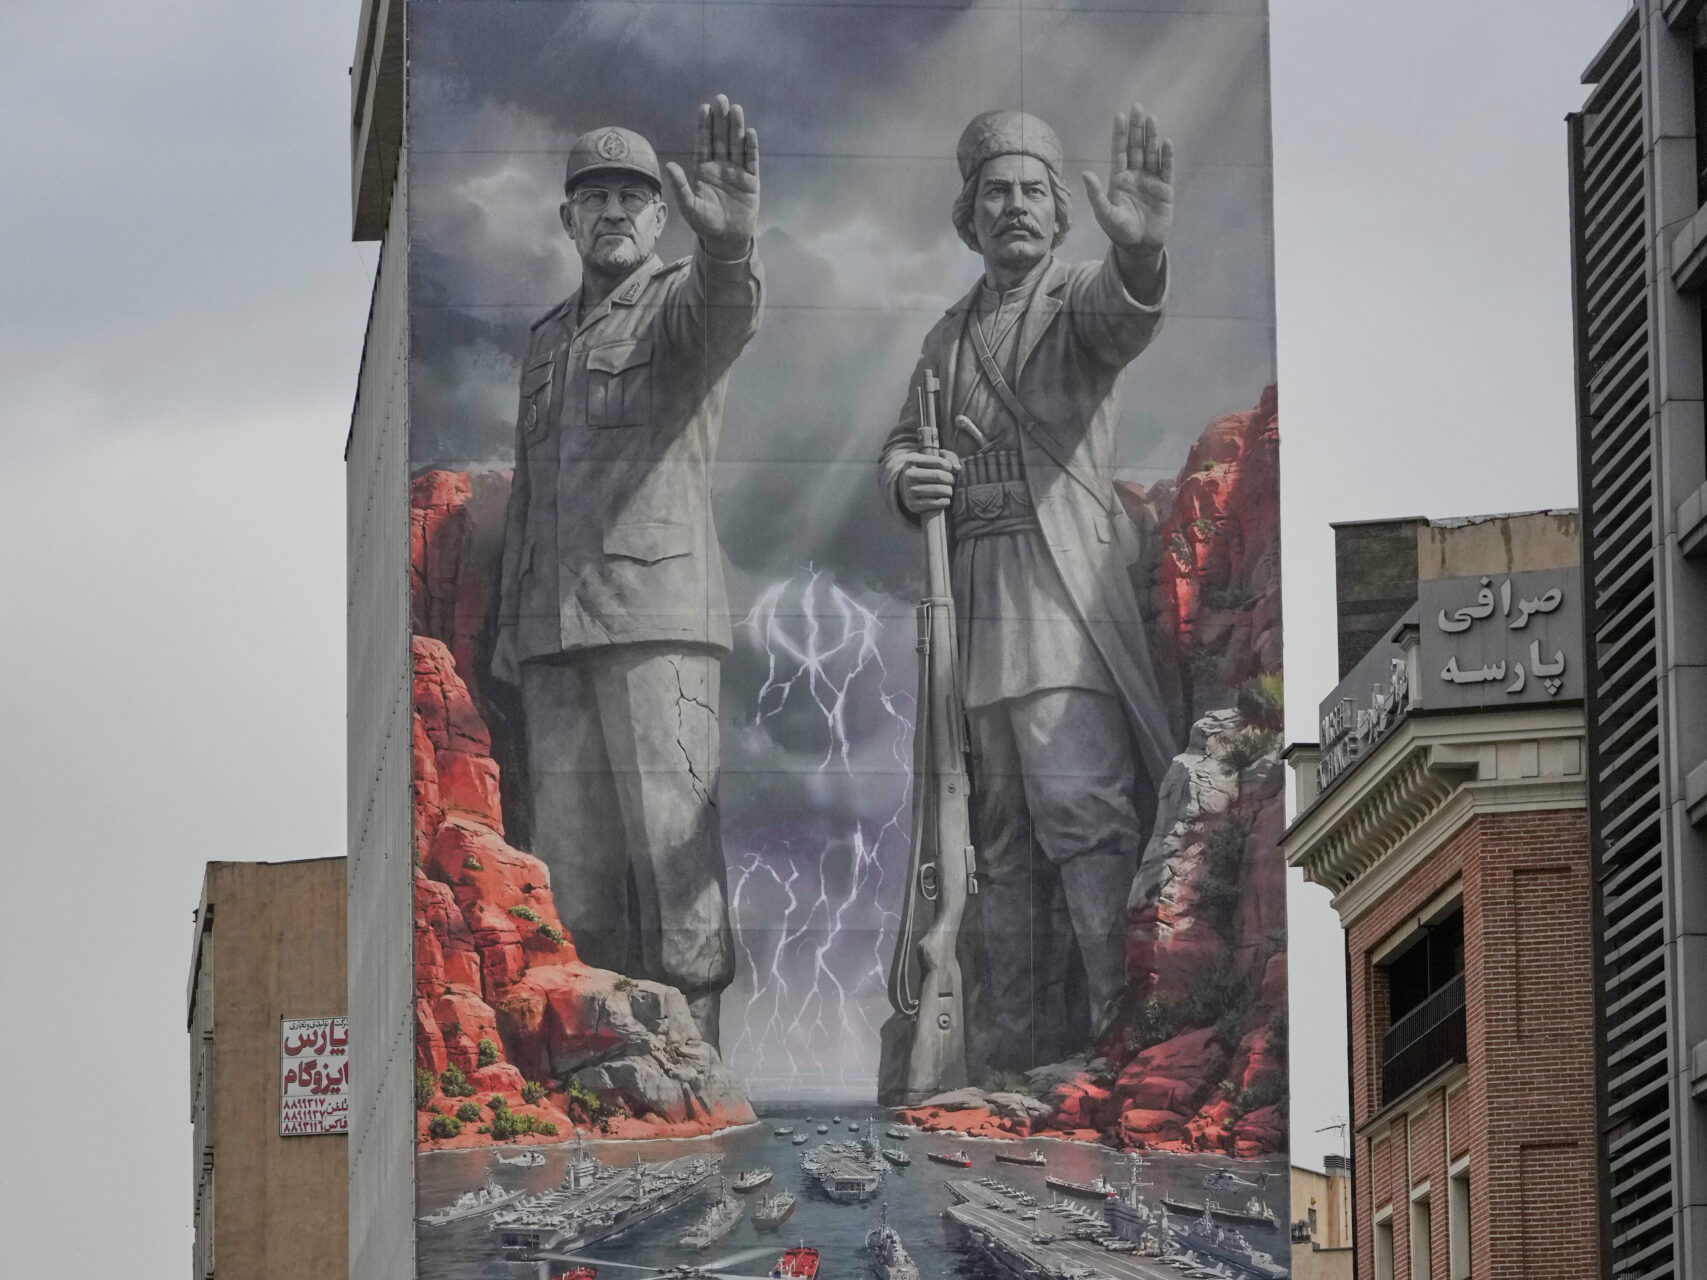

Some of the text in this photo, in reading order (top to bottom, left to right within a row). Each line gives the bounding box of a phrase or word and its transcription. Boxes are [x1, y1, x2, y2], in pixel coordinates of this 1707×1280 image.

[1438, 576, 1562, 632] صرافی
[1440, 640, 1565, 695] پارسه
[284, 1059, 348, 1095] ایزوگام
[324, 1115, 348, 1132] فاکس
